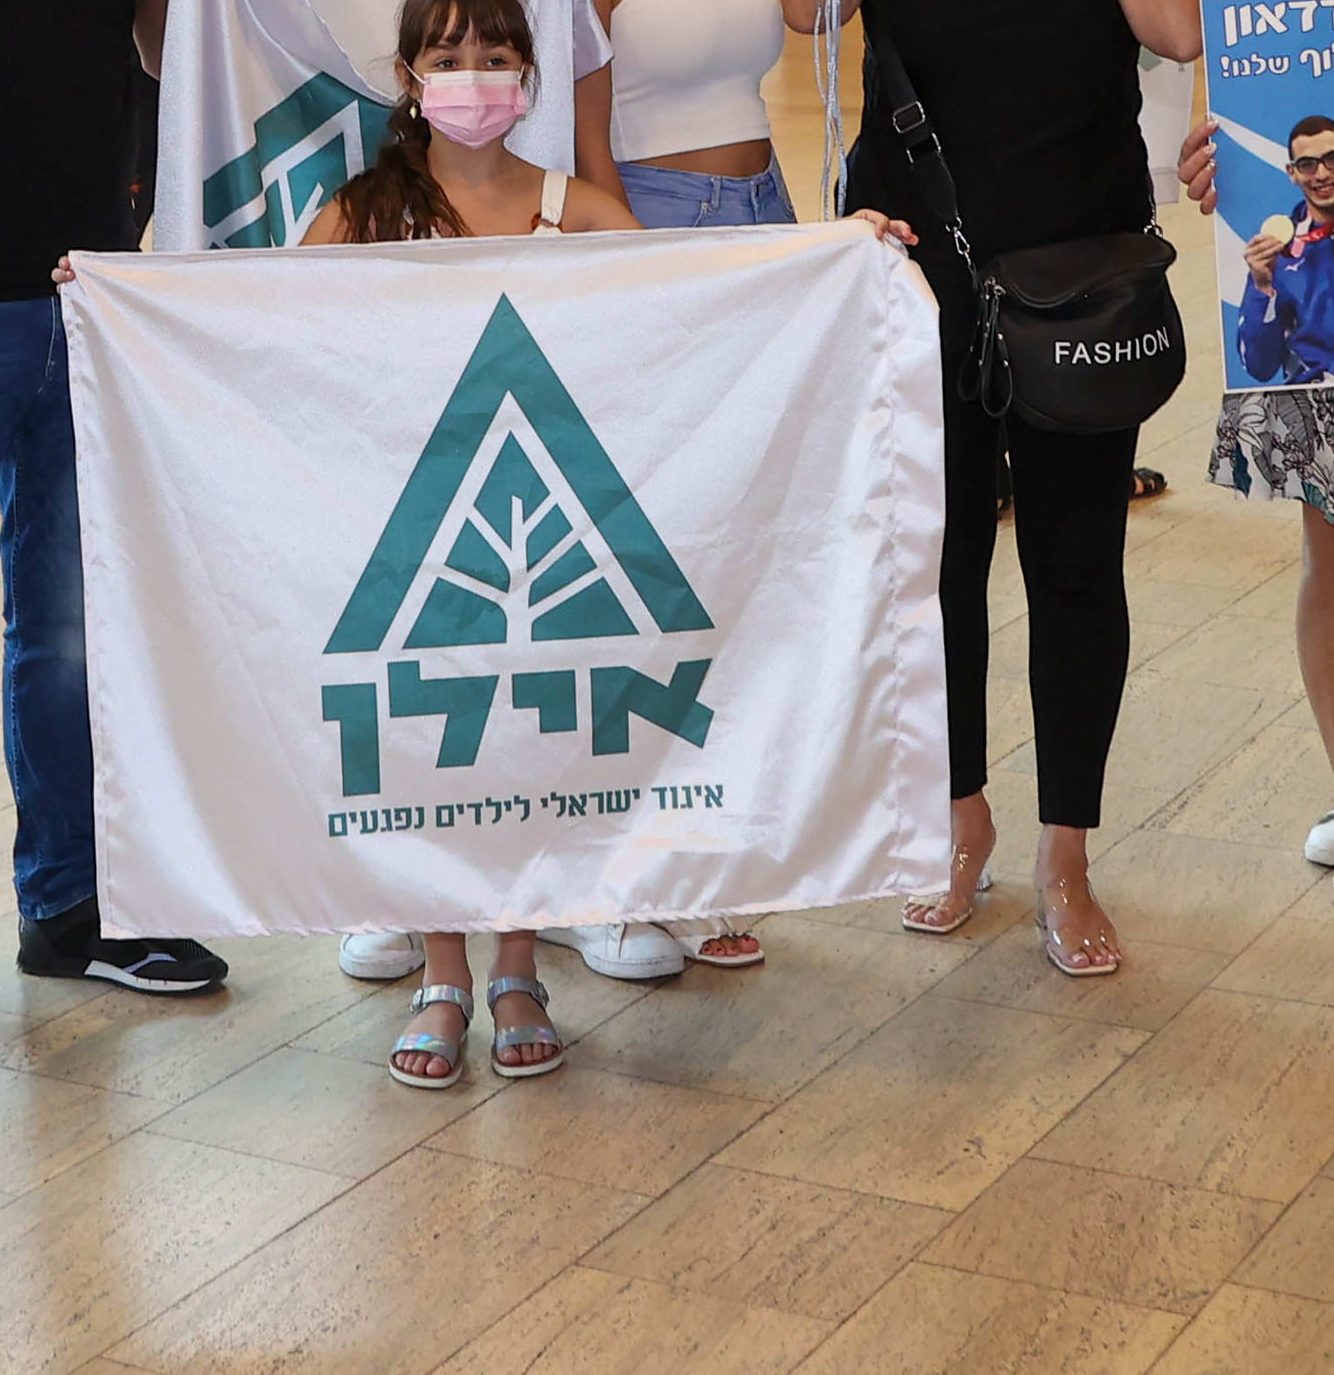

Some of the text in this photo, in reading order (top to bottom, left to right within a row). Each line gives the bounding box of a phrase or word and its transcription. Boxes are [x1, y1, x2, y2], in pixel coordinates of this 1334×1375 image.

[1220, 54, 1290, 78] שלנו!
[1054, 326, 1170, 364] FASHION
[321, 658, 715, 797] אילן
[328, 783, 724, 837] איגוד ישראלי לילדים נפגעים
